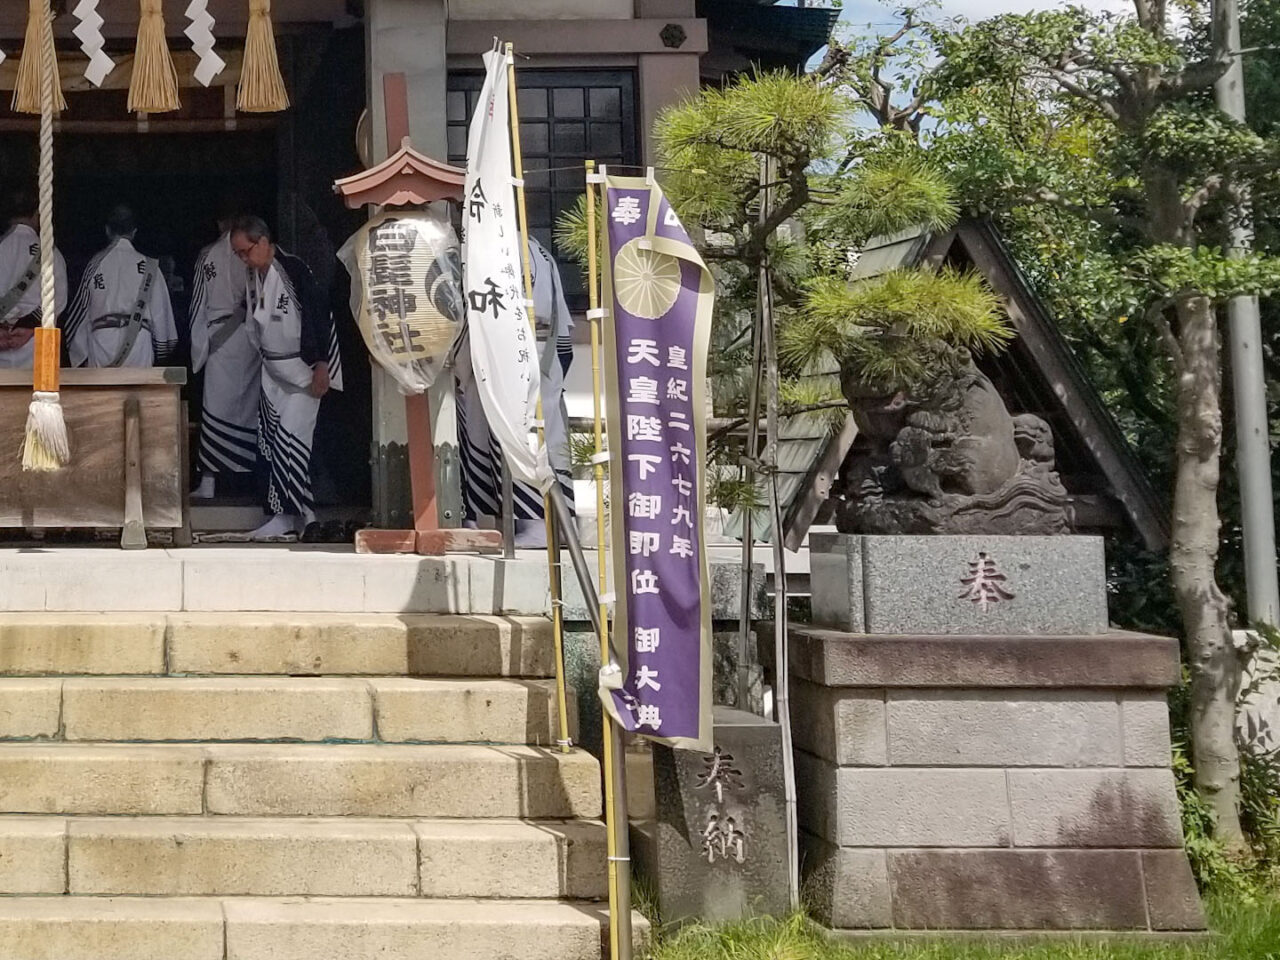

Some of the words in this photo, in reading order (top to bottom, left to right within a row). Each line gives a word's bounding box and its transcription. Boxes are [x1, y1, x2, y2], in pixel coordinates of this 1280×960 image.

[626, 339, 662, 595] 天皇陛下御即位
[666, 345, 694, 559] 皇紀二六七九年
[958, 552, 1016, 615] 奉
[634, 627, 663, 732] 御大典
[696, 745, 746, 863] 奉納
